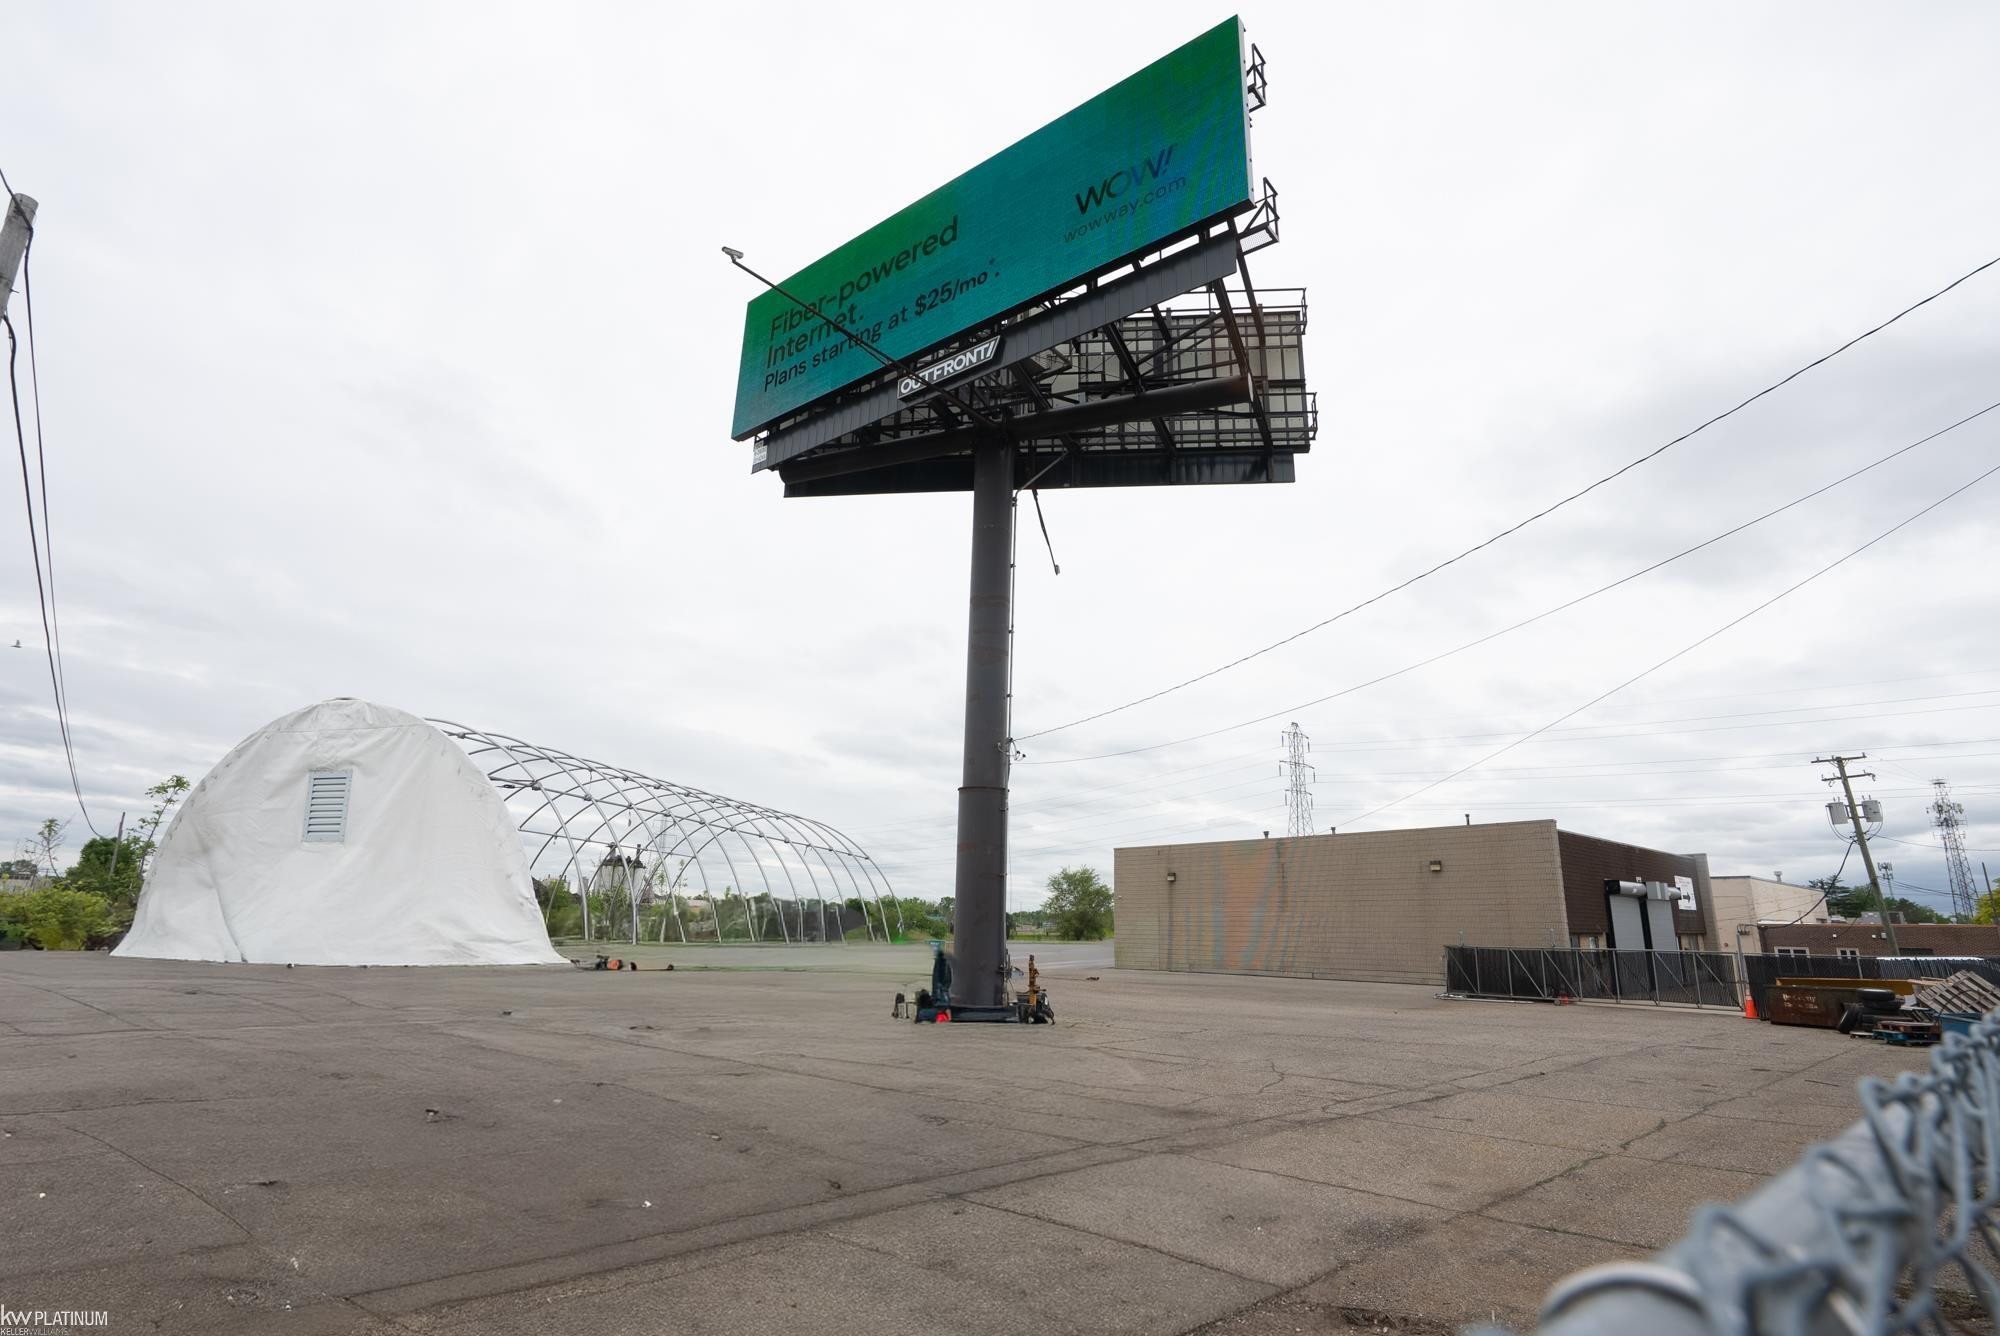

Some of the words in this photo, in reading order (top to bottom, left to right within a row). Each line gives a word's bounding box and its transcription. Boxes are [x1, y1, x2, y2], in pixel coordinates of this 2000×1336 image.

[1063, 176, 1187, 243] wowway.com
[769, 214, 958, 341] Fiber-powered
[764, 361, 807, 392] Plans
[812, 320, 882, 368] starting
[887, 305, 909, 331] at
[766, 303, 864, 368] Internet.
